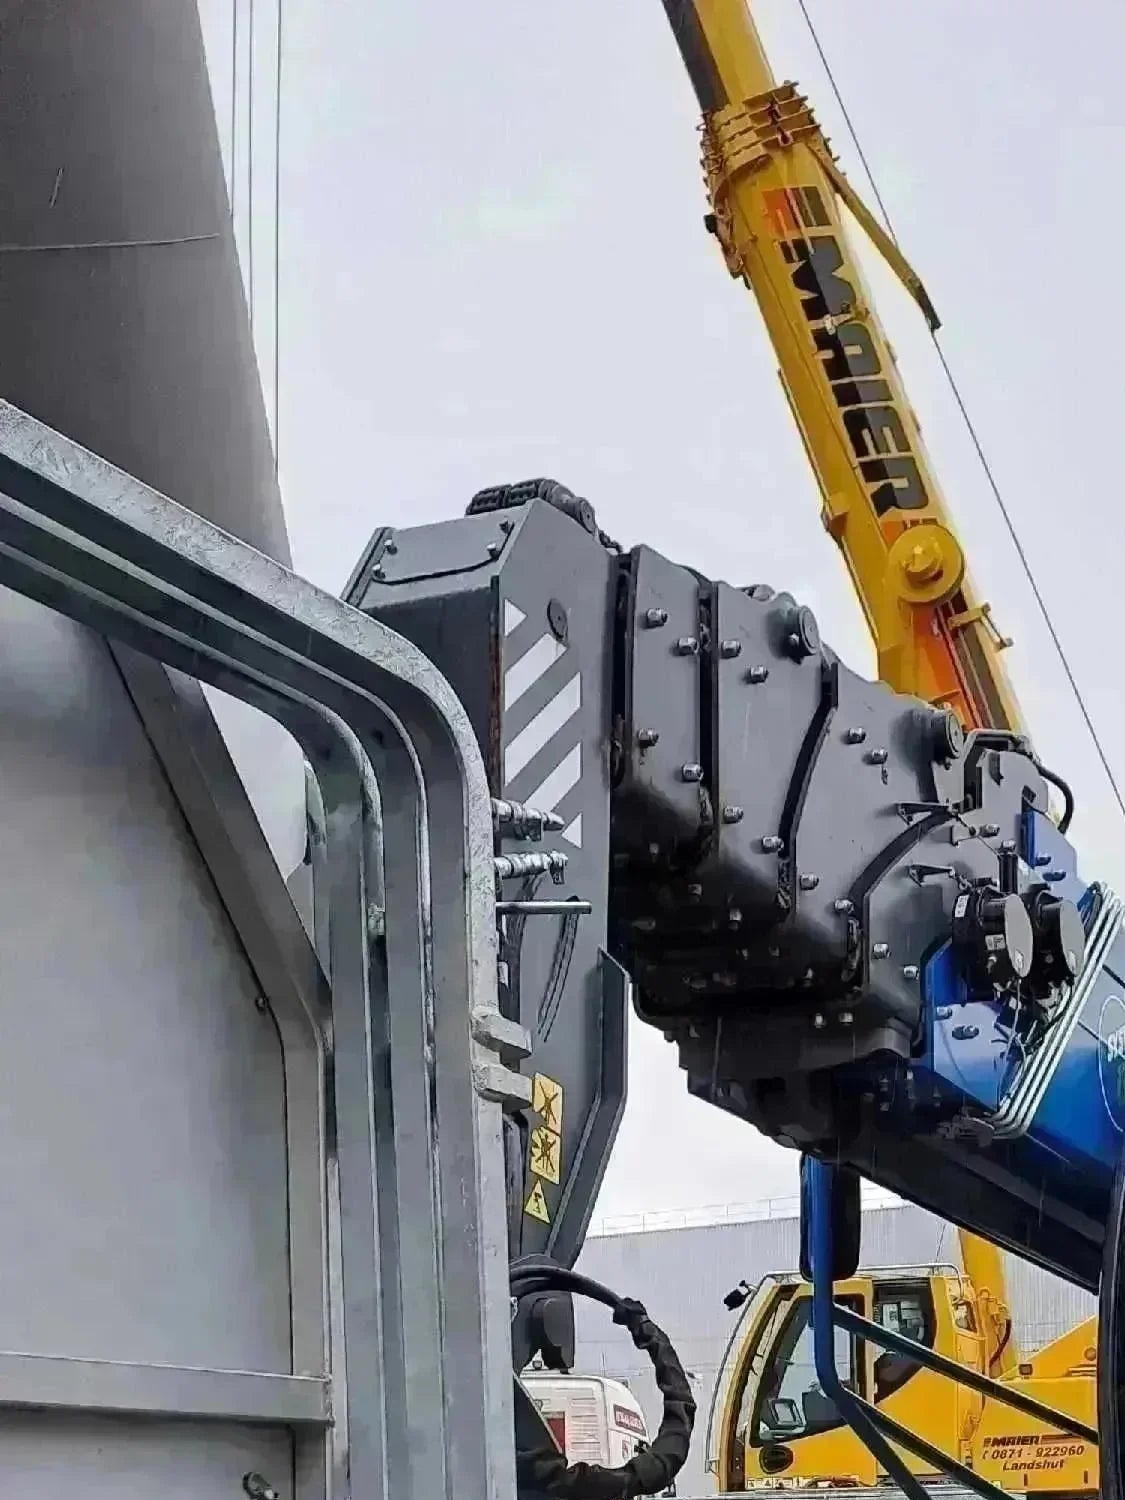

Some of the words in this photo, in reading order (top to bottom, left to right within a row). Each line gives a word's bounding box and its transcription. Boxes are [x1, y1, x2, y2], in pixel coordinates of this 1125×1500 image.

[780, 236, 929, 518] MAIER
[991, 1435, 1040, 1447] MAIER
[991, 1447, 1023, 1460] 0871
[1035, 1445, 1085, 1458] 922960
[1003, 1459, 1065, 1471] Landshut
